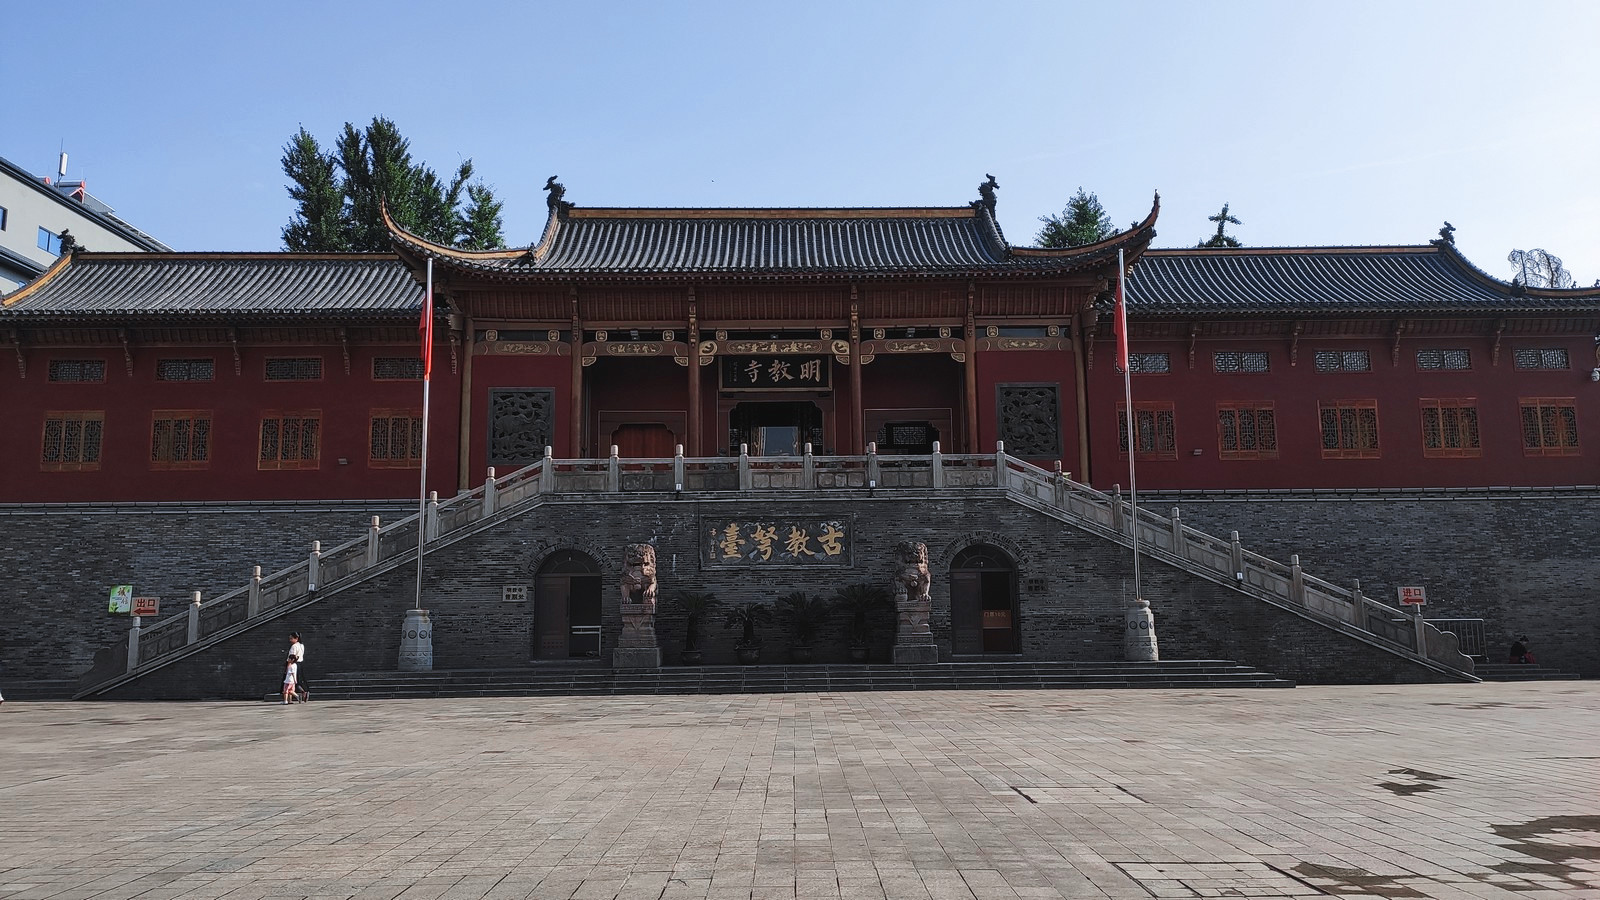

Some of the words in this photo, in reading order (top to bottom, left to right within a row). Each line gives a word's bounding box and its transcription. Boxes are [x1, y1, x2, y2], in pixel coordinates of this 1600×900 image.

[744, 359, 822, 383] 明教寺
[719, 522, 844, 560] 古教弩臺
[1402, 587, 1422, 597] 进口
[137, 598, 156, 607] 出口
